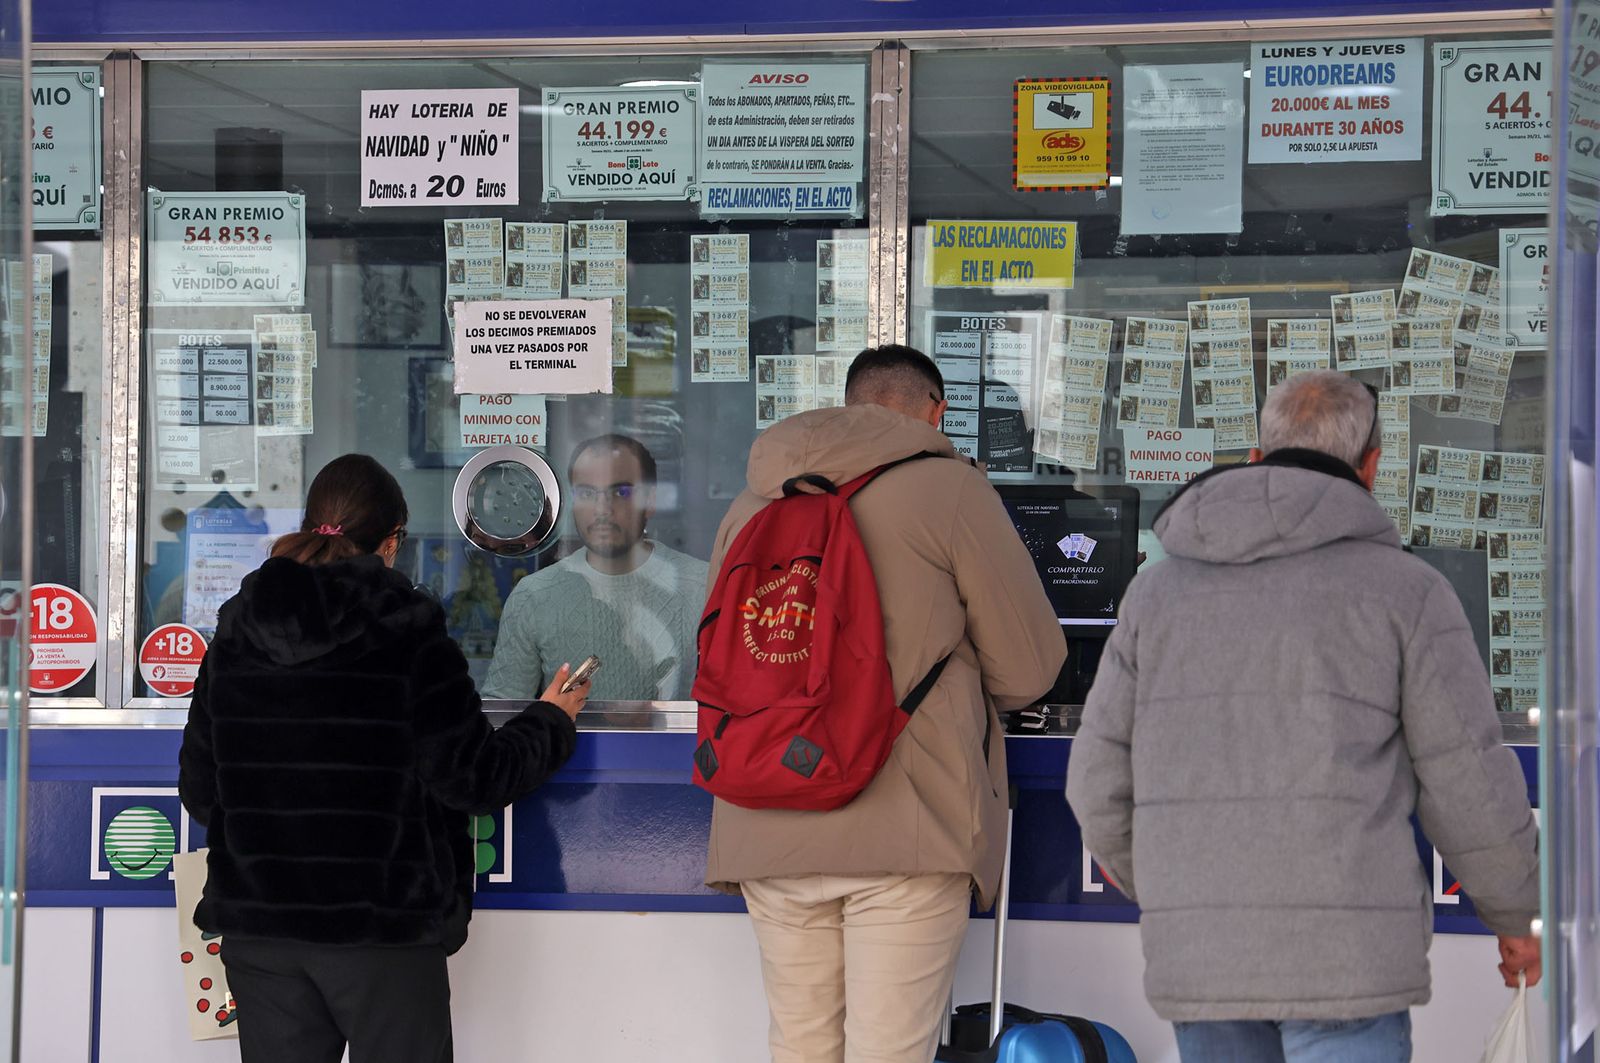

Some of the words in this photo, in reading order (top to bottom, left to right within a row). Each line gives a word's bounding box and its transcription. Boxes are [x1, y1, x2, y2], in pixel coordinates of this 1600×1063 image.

[1261, 47, 1317, 58] LUNES
[1322, 47, 1334, 56] Y
[1338, 44, 1406, 56] JUEVES
[748, 73, 810, 84] AVISO
[1265, 62, 1396, 87] EURODREAMS
[1464, 62, 1542, 83] GRAN
[1020, 84, 1043, 92] ZONA
[1044, 83, 1105, 91] VIDEOVIGILADA
[31, 87, 71, 106] MIO
[708, 95, 726, 106] Todos
[727, 96, 736, 106] los
[737, 95, 773, 108] ABONADOS,
[774, 95, 813, 108] APARTADOS,
[813, 93, 836, 108] PEÑAS,
[1271, 97, 1330, 112] 20.000€
[1333, 96, 1353, 111] AL
[1357, 95, 1391, 110] MES
[369, 104, 399, 118] HAY
[411, 103, 474, 118] LOTERIA
[487, 102, 508, 118] DE
[563, 102, 611, 115] GRAN
[618, 100, 680, 114] PREMIO
[707, 115, 717, 125] de
[717, 117, 733, 126] esta
[788, 115, 810, 126] deben
[810, 118, 822, 126] ser
[823, 115, 855, 126] retirados
[1261, 122, 1334, 137] DURANTE
[1338, 121, 1357, 135] 30
[1360, 117, 1404, 135] AÑOS
[1485, 122, 1491, 130] 5
[1492, 120, 1536, 130] ACIERTOS
[577, 120, 655, 140] 44.199
[659, 127, 668, 137] €
[707, 136, 718, 147] UN
[718, 136, 731, 147] DIA
[732, 136, 756, 147] ANTES
[757, 136, 767, 147] DE
[768, 136, 778, 147] LA
[779, 136, 809, 147] VISPERA
[810, 136, 825, 147] DEL
[826, 136, 855, 147] SORTEO
[1047, 132, 1080, 149] ads
[1288, 143, 1303, 152] POR
[1303, 142, 1322, 152] SOLO
[1322, 142, 1338, 153] 2,5€
[1338, 142, 1348, 151] LA
[1348, 141, 1378, 151] APUESTA
[365, 135, 430, 157] NAVIDAD
[437, 139, 447, 162] y
[607, 161, 626, 169] Bono
[642, 160, 659, 168] Loto
[706, 159, 715, 170] de
[715, 159, 722, 170] lo
[722, 159, 750, 172] contrario,
[751, 159, 760, 170] SE
[760, 157, 789, 170] PONDRÁN
[790, 160, 795, 170] A
[796, 160, 804, 170] LA
[805, 159, 827, 170] VENTA.
[1036, 155, 1053, 163] 959
[568, 173, 633, 186] VENDIDO
[638, 169, 676, 184] AQUÍ
[1468, 171, 1551, 190] VENDID
[369, 179, 407, 199] Dcmos.
[410, 184, 417, 199] a
[426, 175, 466, 198] 20
[476, 178, 507, 198] Euros
[32, 185, 67, 206] QUÍ
[707, 187, 793, 212] RECLAMACIONES,
[795, 187, 809, 208] EN
[811, 187, 824, 208] EL
[825, 187, 852, 207] ACTO
[168, 207, 217, 220] GRAN
[223, 207, 285, 220] PREMIO
[184, 226, 260, 245] 54.853
[264, 234, 273, 244] €
[932, 225, 956, 248] LAS
[958, 226, 1067, 249] RECLAMACIONES
[206, 266, 217, 274] La
[233, 266, 270, 275] Primitiva
[961, 259, 979, 282] EN
[982, 260, 994, 283] EL
[1000, 260, 1034, 283] ACTO
[172, 278, 238, 290] VENDIDO
[242, 275, 280, 290] AQUÍ
[485, 311, 500, 321] NO
[502, 311, 516, 321] SE
[518, 309, 587, 320] DEVOLVERAN
[960, 317, 1006, 330] BOTES
[465, 328, 486, 338] LOS
[488, 327, 534, 338] DECIMOS
[536, 325, 597, 337] PREMIADOS
[178, 335, 223, 346] BOTES
[940, 341, 976, 349] 26.000.000
[470, 344, 492, 354] UNA
[495, 344, 515, 354] VEZ
[517, 342, 565, 353] PASADOS
[567, 342, 589, 352] POR
[509, 360, 522, 370] EL
[524, 359, 577, 370] TERMINAL
[479, 395, 512, 405] PAGO
[463, 415, 513, 425] MINIMO
[515, 415, 541, 425] CON
[463, 434, 512, 445] TARJETA
[515, 434, 529, 444] 10
[531, 434, 539, 444] €
[1146, 430, 1182, 441] PAGO
[1130, 450, 1182, 462] MINIMO
[1185, 451, 1212, 462] CON
[1129, 470, 1181, 482] TARJETA
[1047, 566, 1105, 574] COMPARTIRLO
[155, 632, 194, 655] +18
[742, 622, 769, 662] PERFECT
[770, 647, 809, 664] OUTFIT
